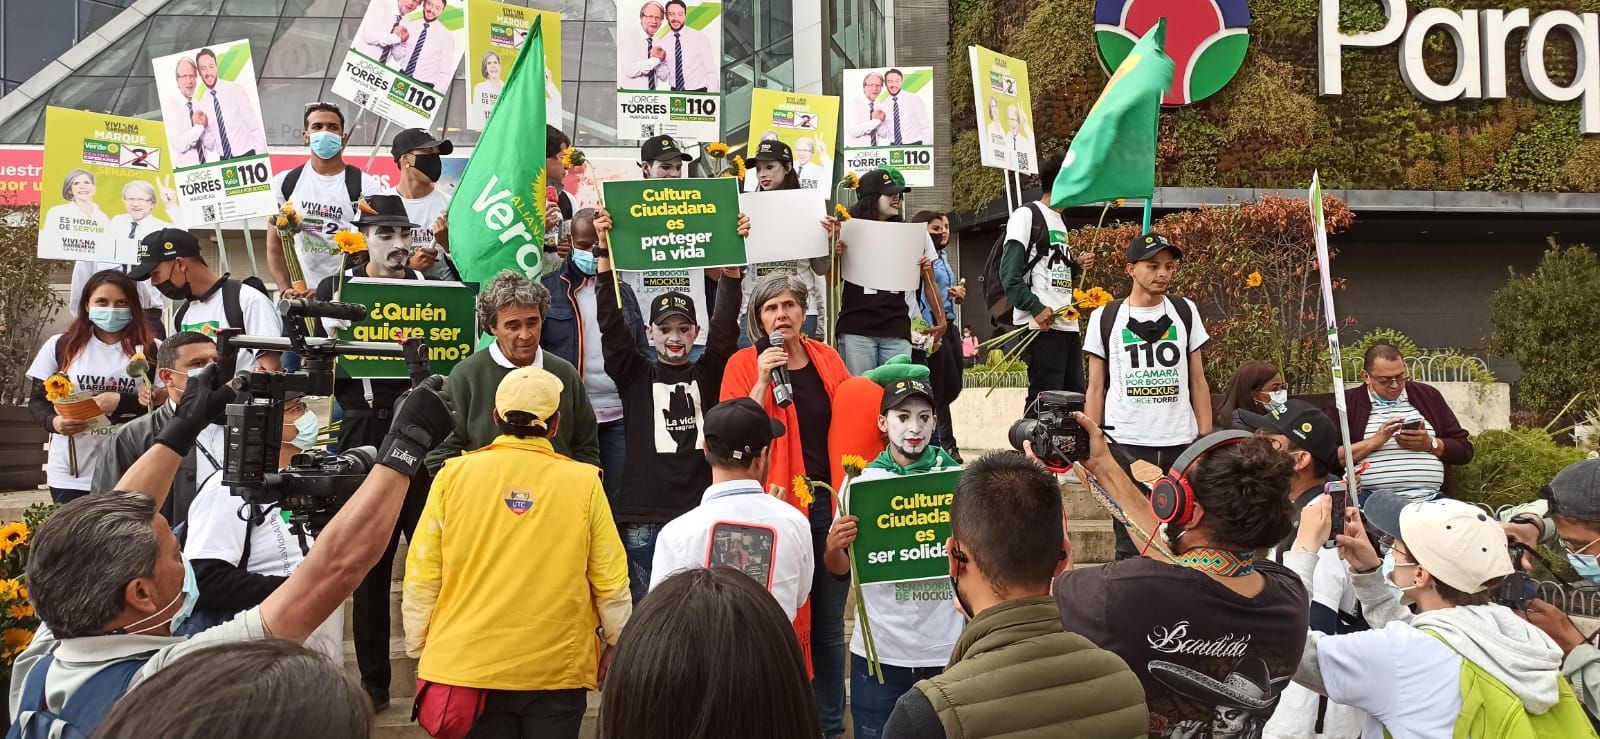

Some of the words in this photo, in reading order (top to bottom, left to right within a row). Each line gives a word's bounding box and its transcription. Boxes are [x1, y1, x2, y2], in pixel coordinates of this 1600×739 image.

[497, 16, 529, 28] MARQUE
[355, 60, 385, 78] JORGE
[1318, 0, 1600, 134] Parq
[346, 62, 389, 90] TORRES
[1006, 79, 1013, 93] 2
[408, 86, 436, 112] 110
[629, 95, 659, 104] JORGE
[621, 104, 667, 114] TORRES
[687, 98, 716, 115] 110
[801, 115, 810, 127] 2
[94, 131, 147, 144] MARQUE
[85, 142, 107, 151] Verde
[131, 148, 148, 167] 2
[848, 158, 887, 168] TORRES
[905, 150, 930, 164] 110
[186, 170, 213, 183] JORGE
[238, 163, 268, 186] 110
[180, 179, 222, 196] TORRES
[642, 188, 701, 201] Cultura
[630, 202, 716, 217] Ciudadana
[60, 216, 70, 224] ES
[73, 218, 98, 226] HORA
[666, 219, 685, 230] es
[73, 225, 104, 233] SERVIR
[326, 223, 339, 234] 2
[641, 232, 712, 250] proteger
[651, 248, 666, 261] la
[670, 246, 705, 260] vida
[674, 297, 686, 306] 110
[370, 303, 446, 321] ¿Quién
[353, 323, 424, 342] quiere
[430, 327, 461, 341] ser
[1124, 341, 1181, 368] 110
[77, 375, 136, 388] VIVIANA
[911, 380, 925, 388] 110
[1133, 386, 1175, 395] MOCKUS
[666, 418, 677, 427] La
[891, 492, 954, 510] Cultura
[877, 510, 951, 529] Ciudada
[915, 530, 935, 543] es
[868, 549, 895, 565] ser
[895, 582, 950, 591] SENADORA
[895, 591, 909, 601] DE
[912, 591, 953, 601] MOCKUS
[1146, 620, 1251, 658] Bandida
